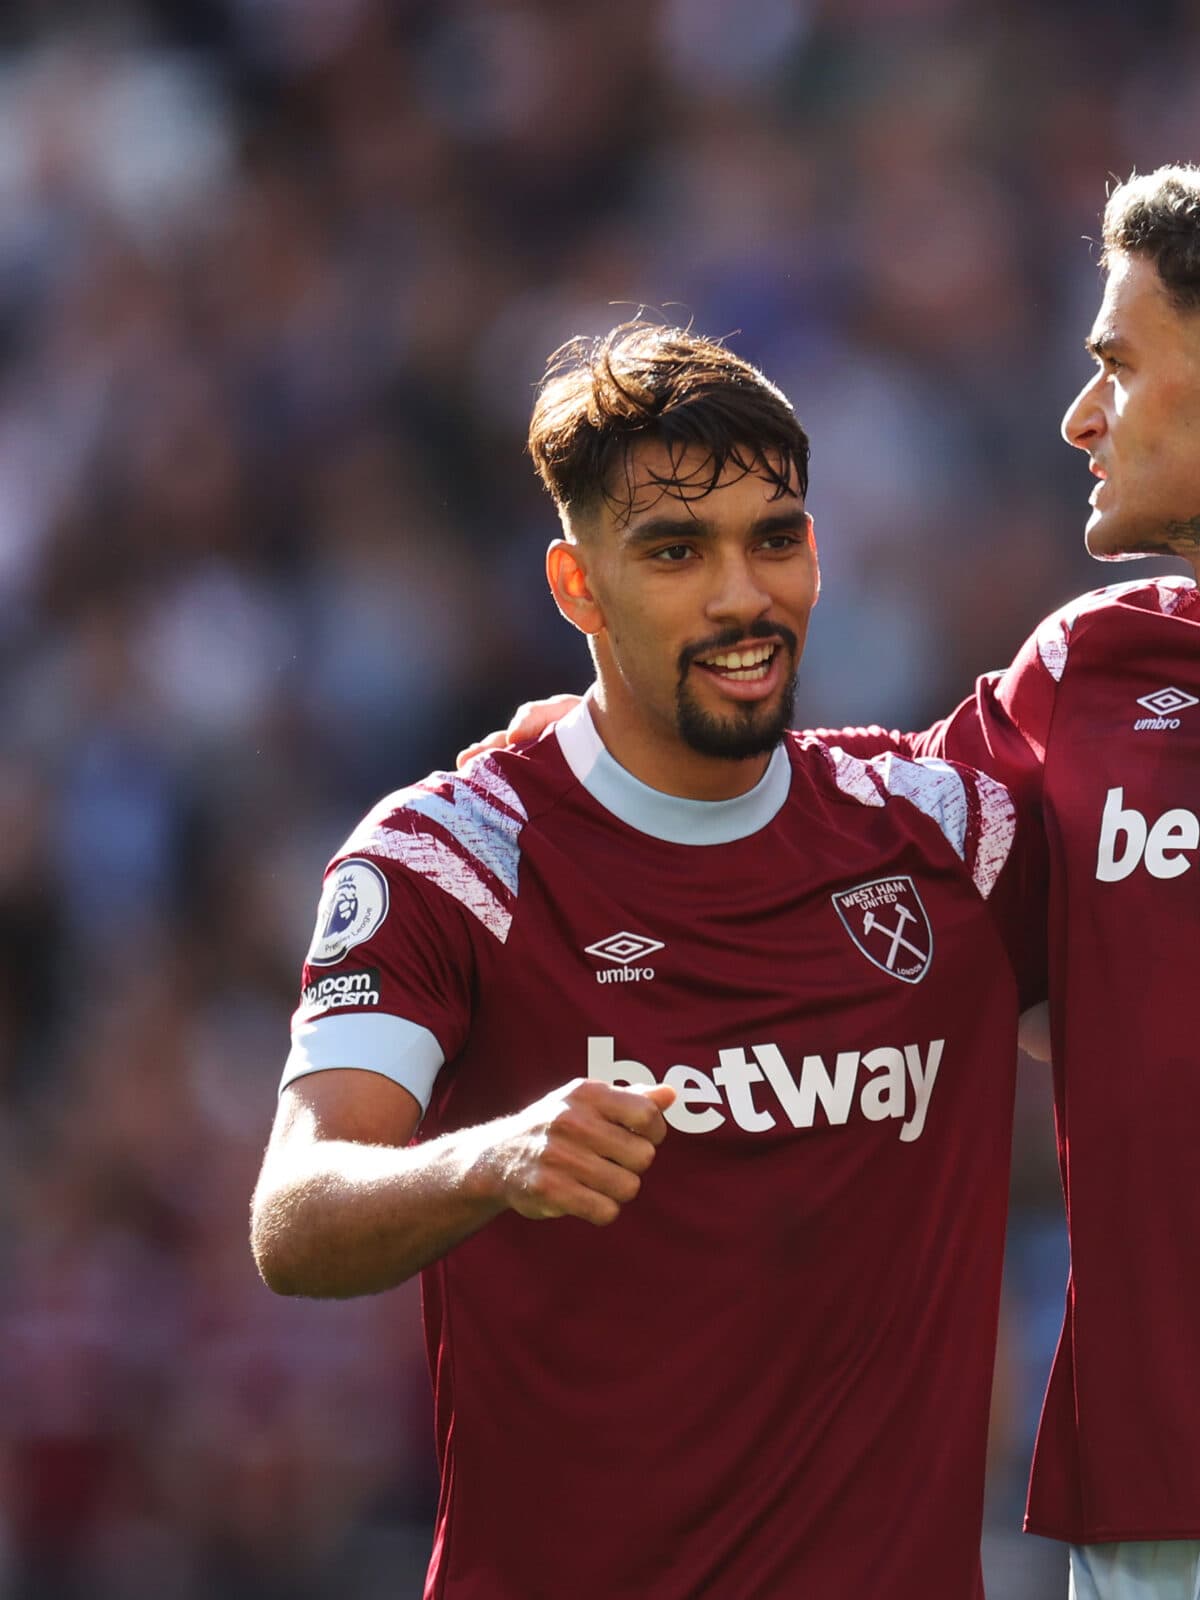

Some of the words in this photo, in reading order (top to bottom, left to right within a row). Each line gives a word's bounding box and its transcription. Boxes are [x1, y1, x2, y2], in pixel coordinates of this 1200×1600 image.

[1133, 716, 1181, 731] umbro
[841, 887, 873, 908] WEST
[875, 881, 907, 897] HAM
[860, 894, 898, 911] UNITED
[596, 965, 655, 984] umbro
[318, 974, 370, 997] room
